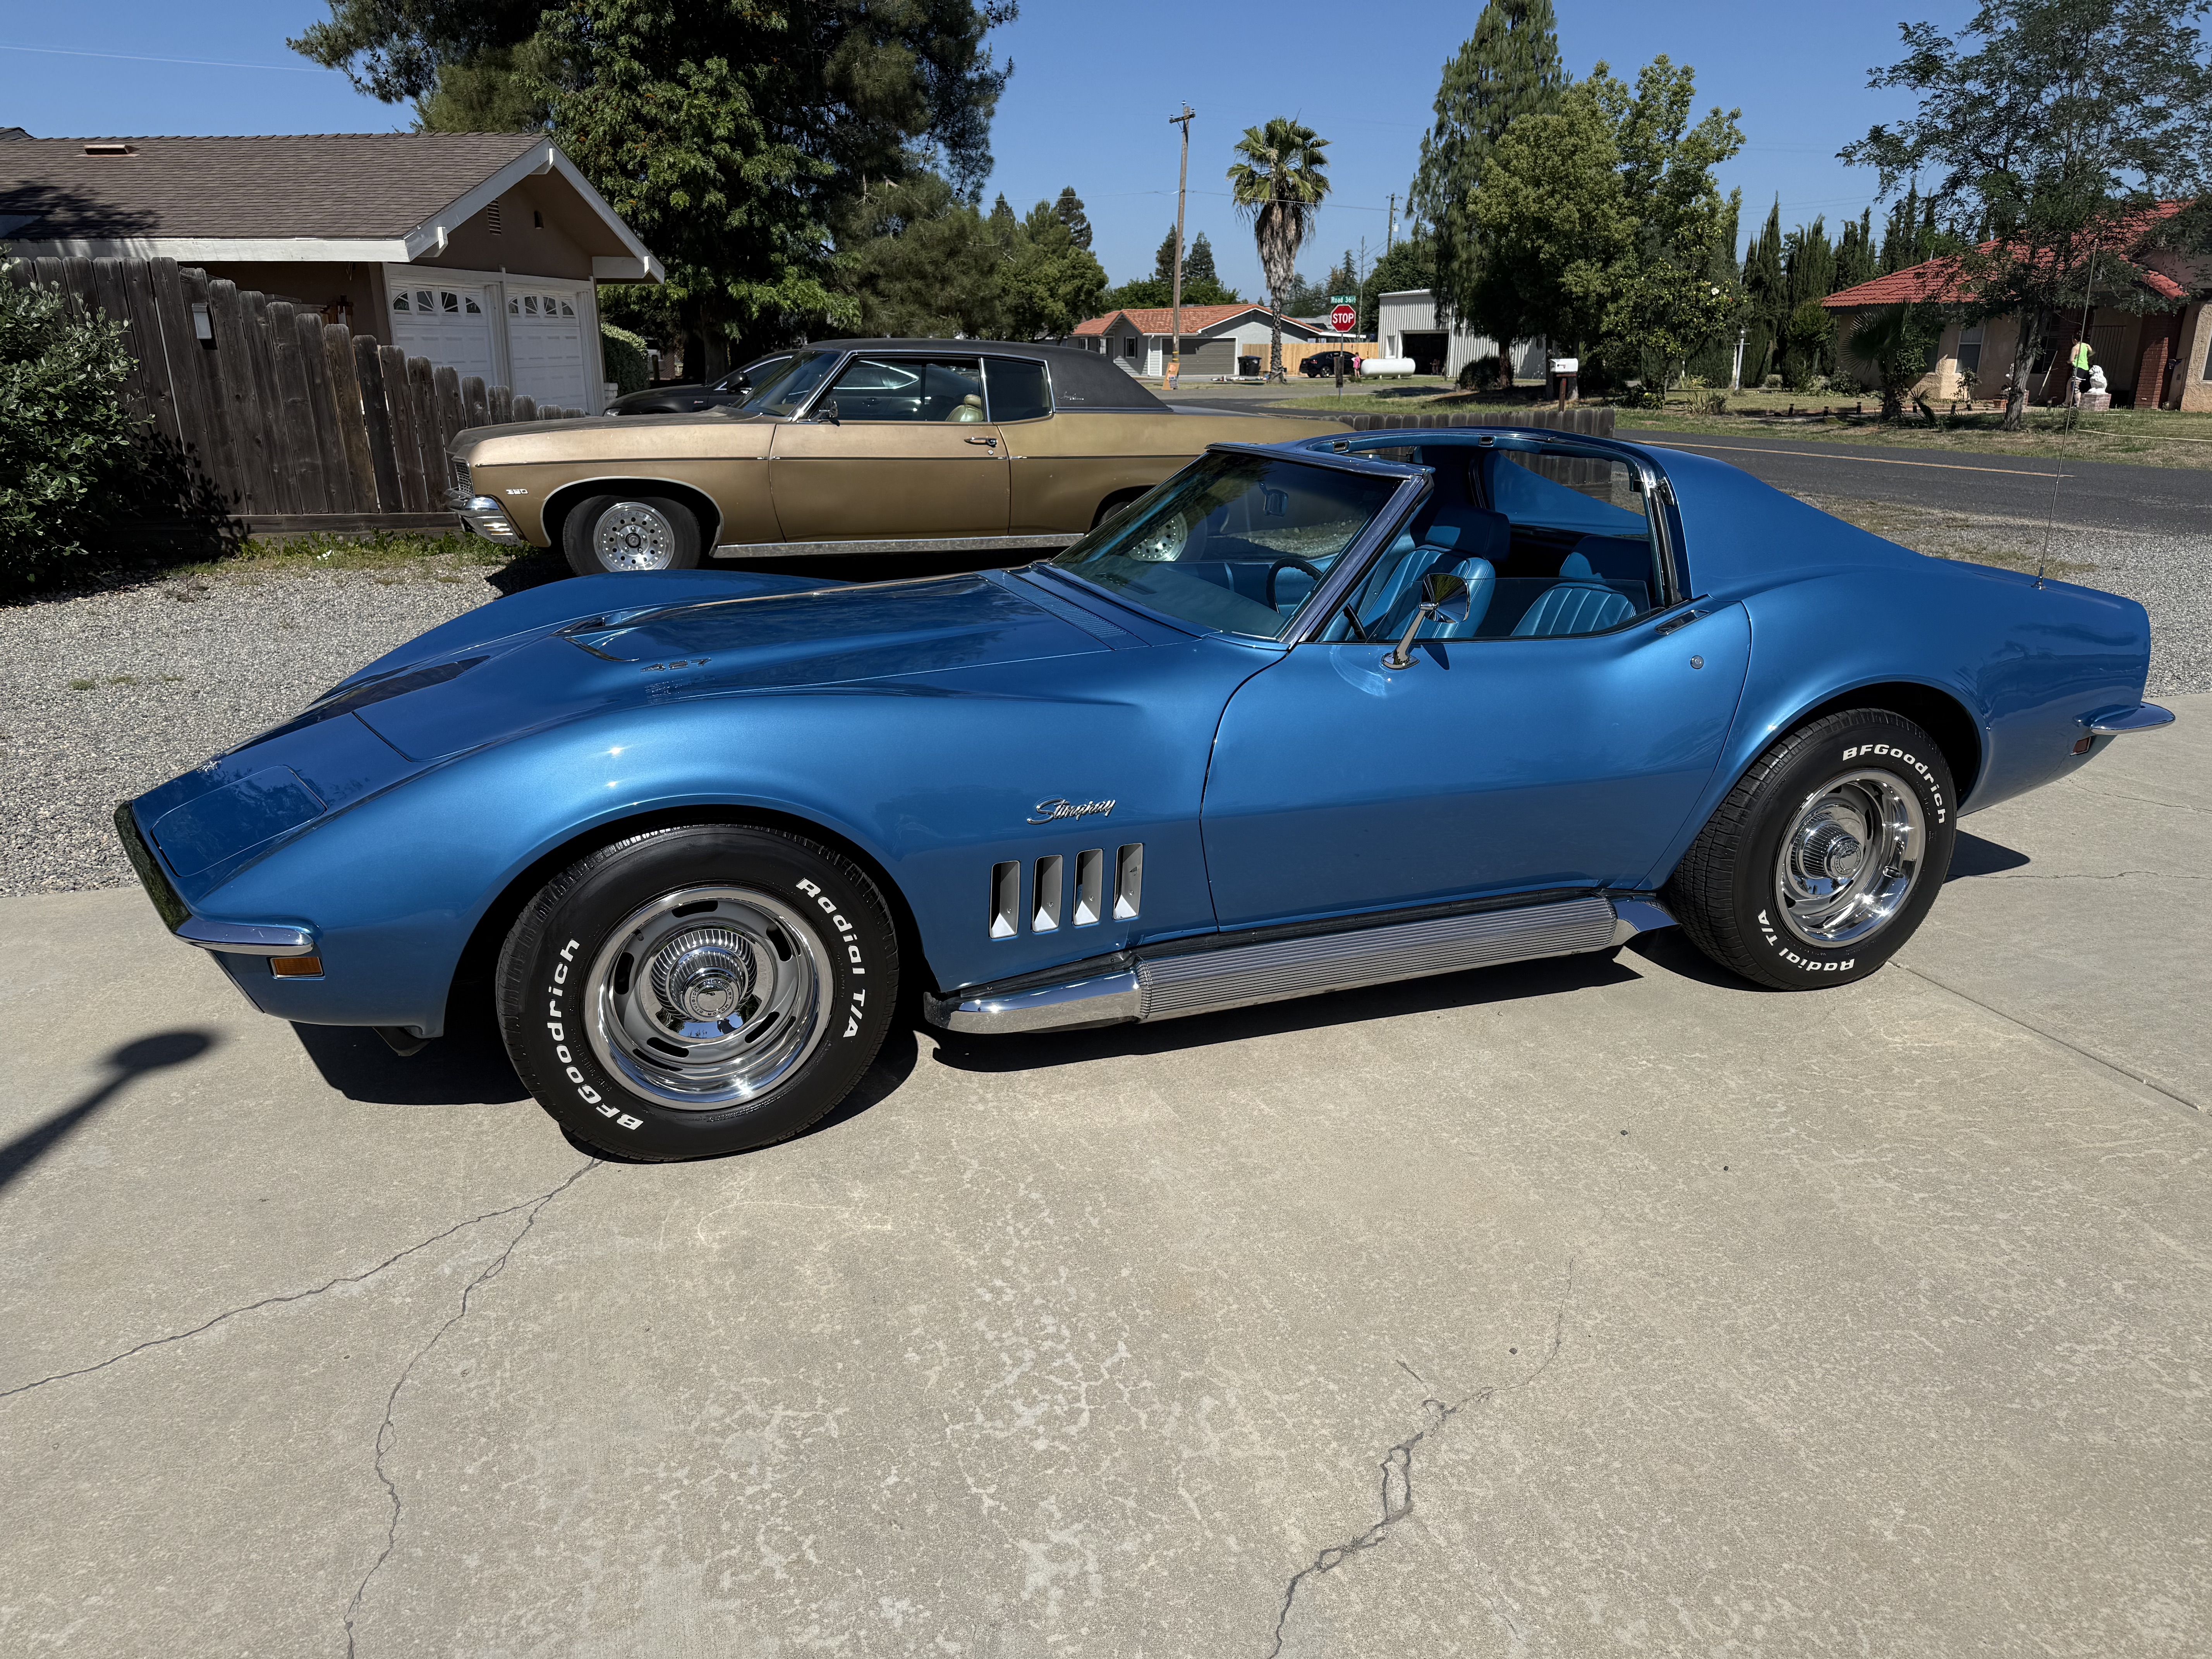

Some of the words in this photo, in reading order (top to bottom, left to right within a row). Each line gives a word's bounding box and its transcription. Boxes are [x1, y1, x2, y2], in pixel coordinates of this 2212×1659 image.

[1333, 313, 1354, 324] STOP
[1843, 744, 1946, 824] BFGoodrich
[1027, 797, 1116, 824] Stingray
[1758, 909, 1778, 946] T/A
[796, 878, 865, 974] Radial
[843, 988, 866, 1038] T/A
[1779, 948, 1855, 971] Radial
[547, 939, 644, 1130] BFGoodrich
